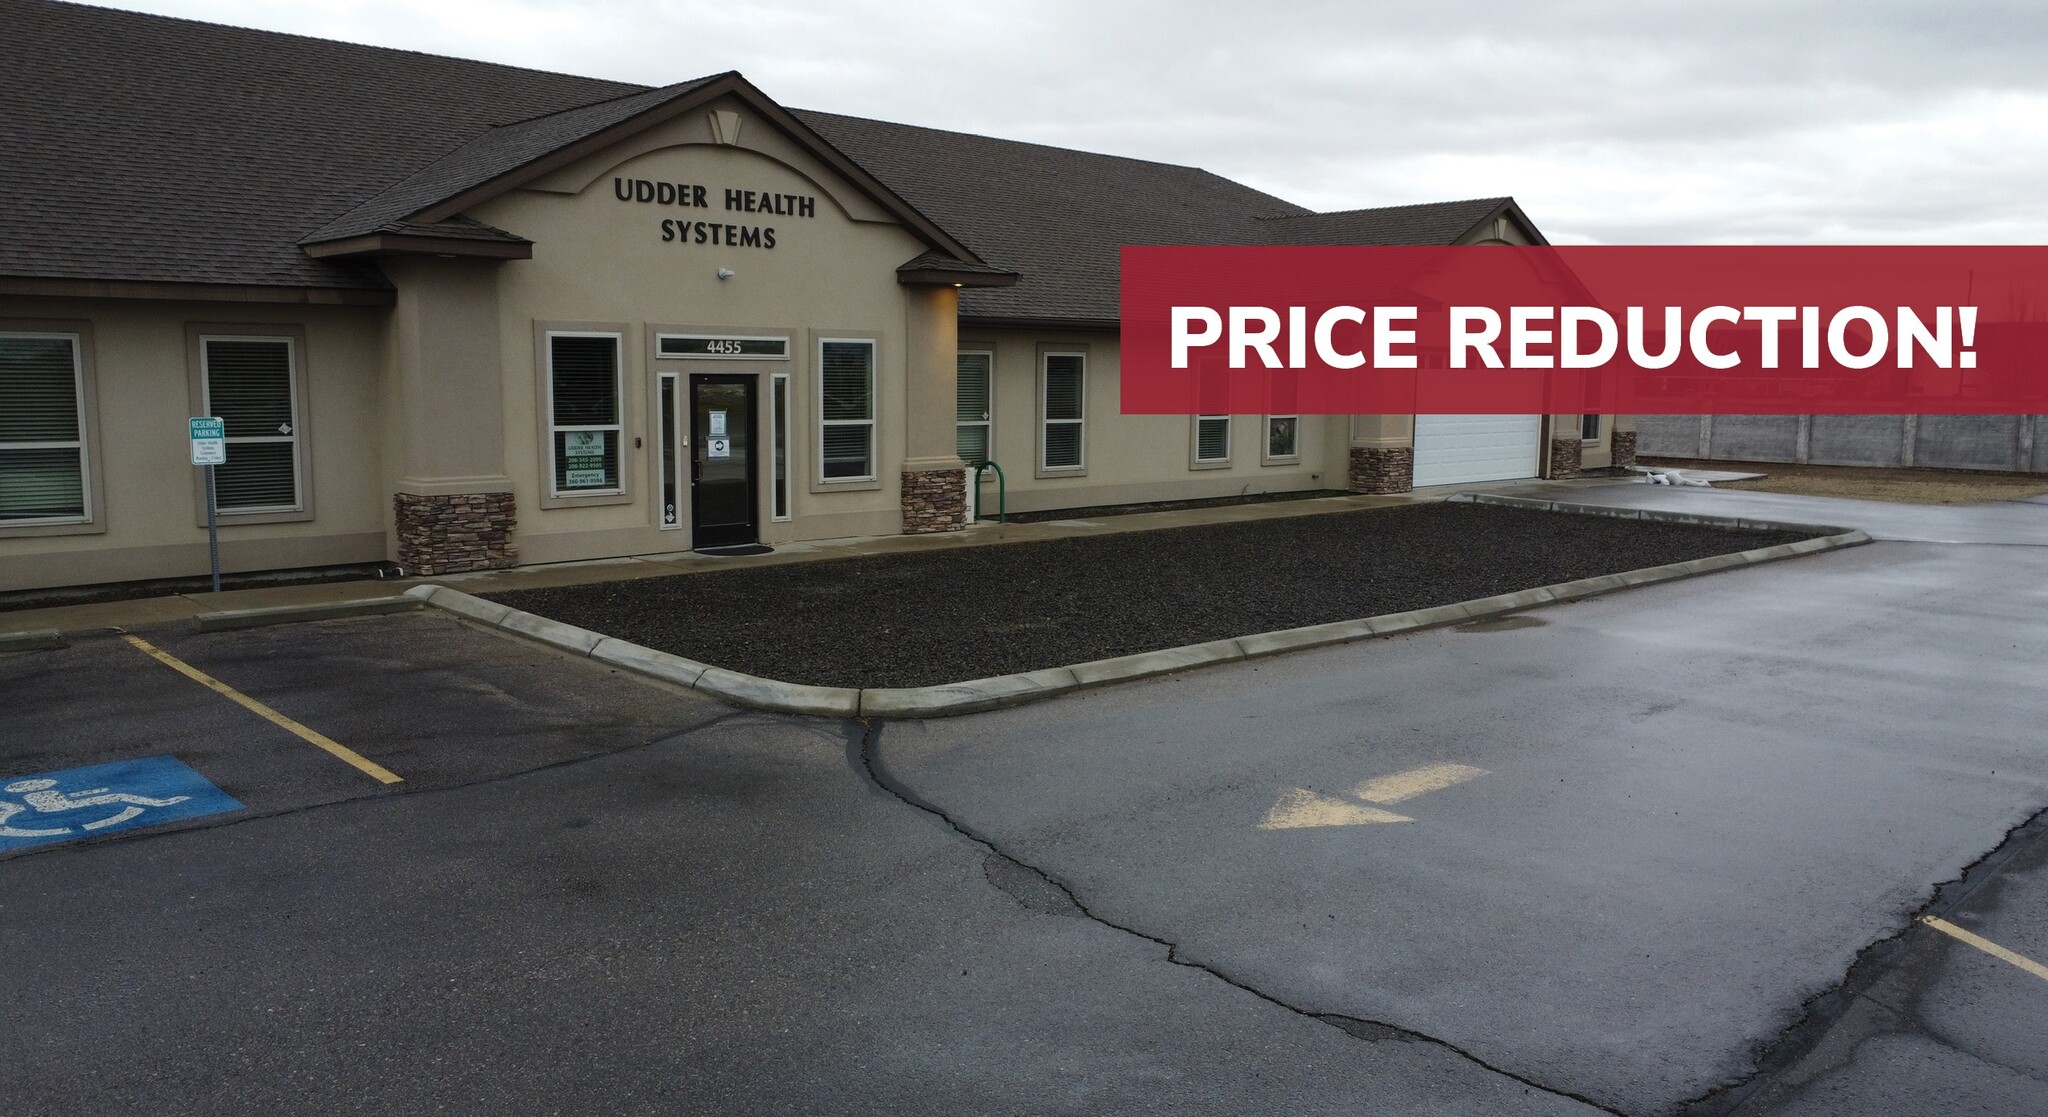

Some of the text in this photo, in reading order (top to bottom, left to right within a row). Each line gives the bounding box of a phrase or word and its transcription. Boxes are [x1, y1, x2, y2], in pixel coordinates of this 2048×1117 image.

[615, 177, 815, 218] UDDER HEALTH
[661, 219, 776, 249] SYSTEMS
[707, 340, 742, 354] 4455
[191, 420, 221, 428] RESERVED
[193, 429, 220, 437] PARKING
